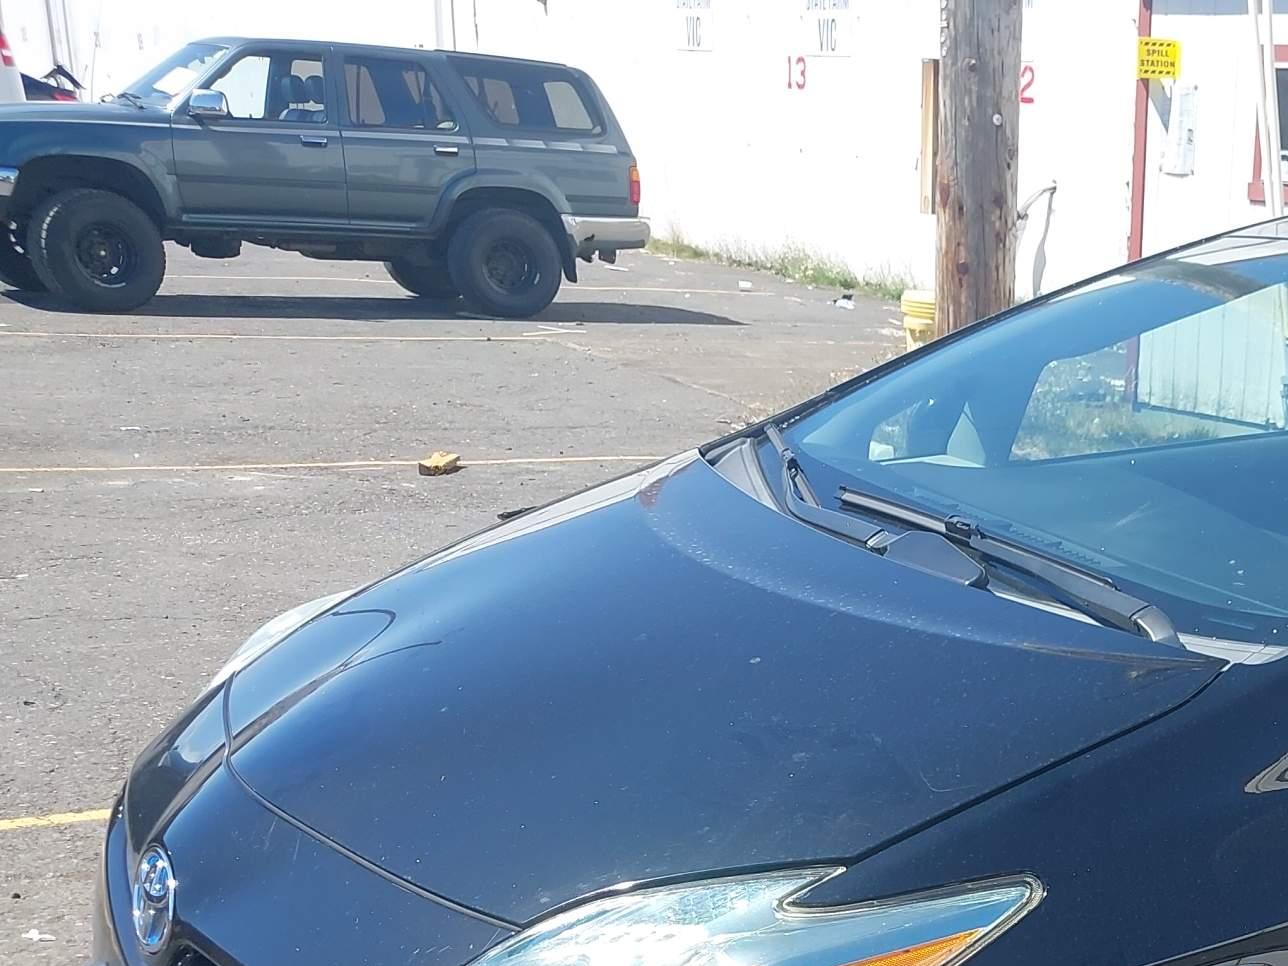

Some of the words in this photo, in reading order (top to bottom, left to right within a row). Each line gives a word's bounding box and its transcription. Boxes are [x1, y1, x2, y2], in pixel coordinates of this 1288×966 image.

[686, 16, 701, 47] VIC
[818, 18, 837, 51] VIC
[1140, 59, 1175, 68] STATION
[1146, 49, 1170, 57] SPILL
[787, 56, 806, 90] 13
